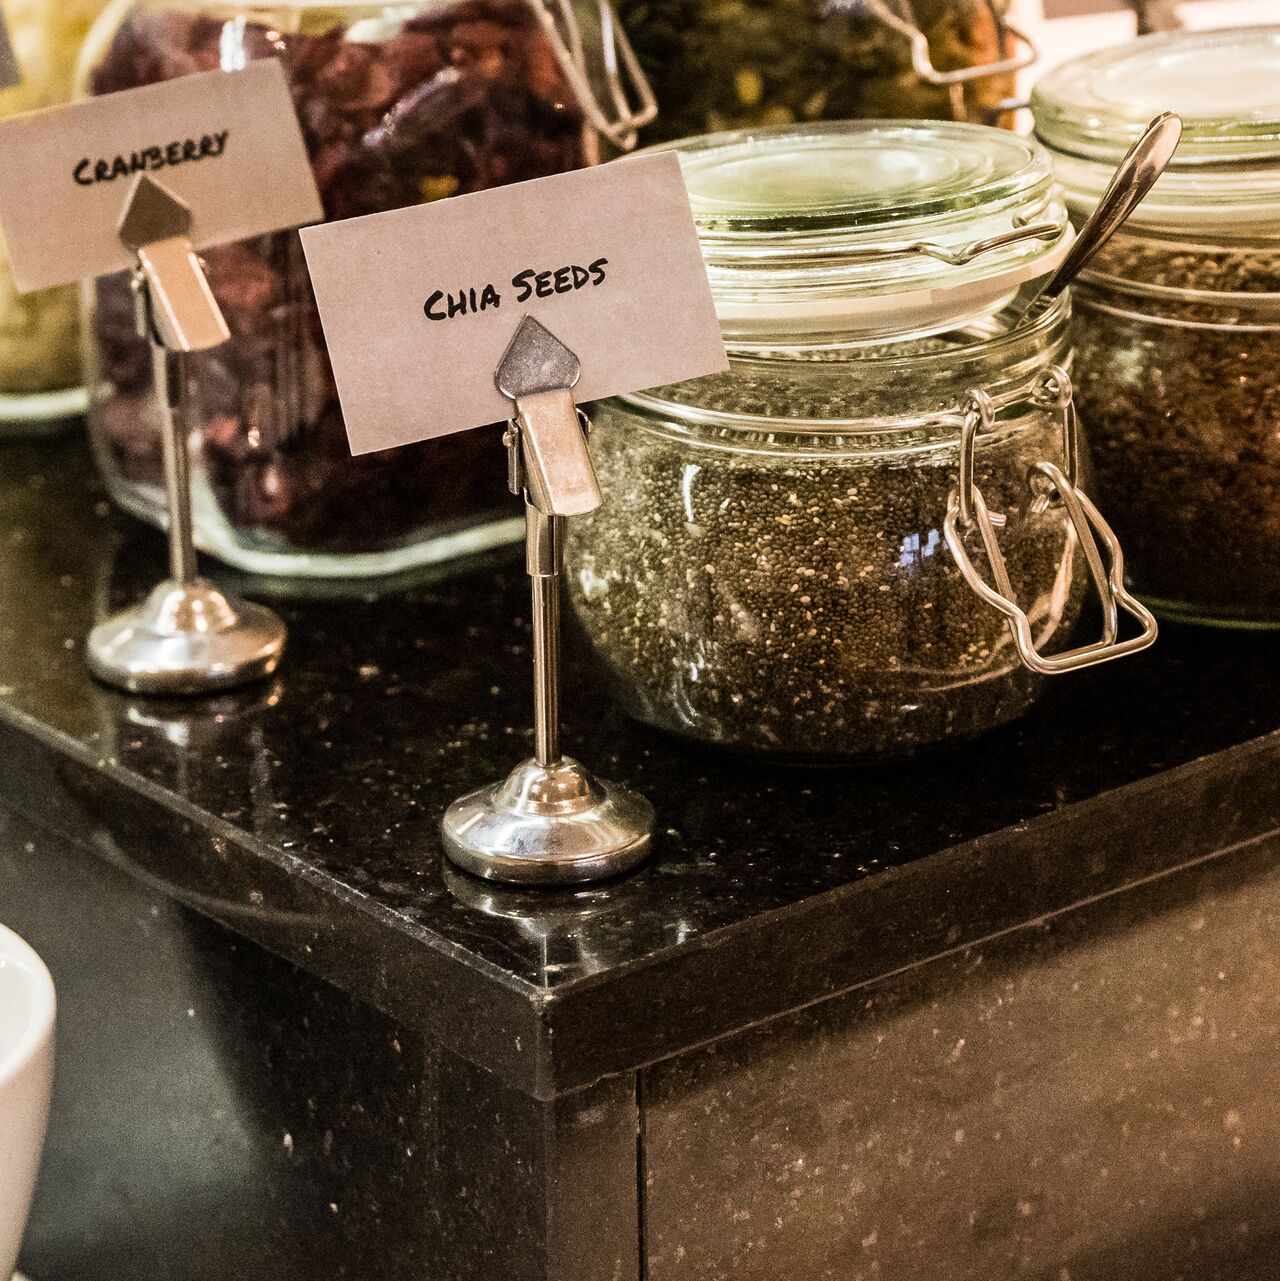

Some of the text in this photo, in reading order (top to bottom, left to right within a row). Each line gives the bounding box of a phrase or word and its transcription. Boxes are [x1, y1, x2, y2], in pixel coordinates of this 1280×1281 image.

[73, 129, 228, 186] CRANBERRY
[424, 257, 608, 321] CHIA SEEDS
